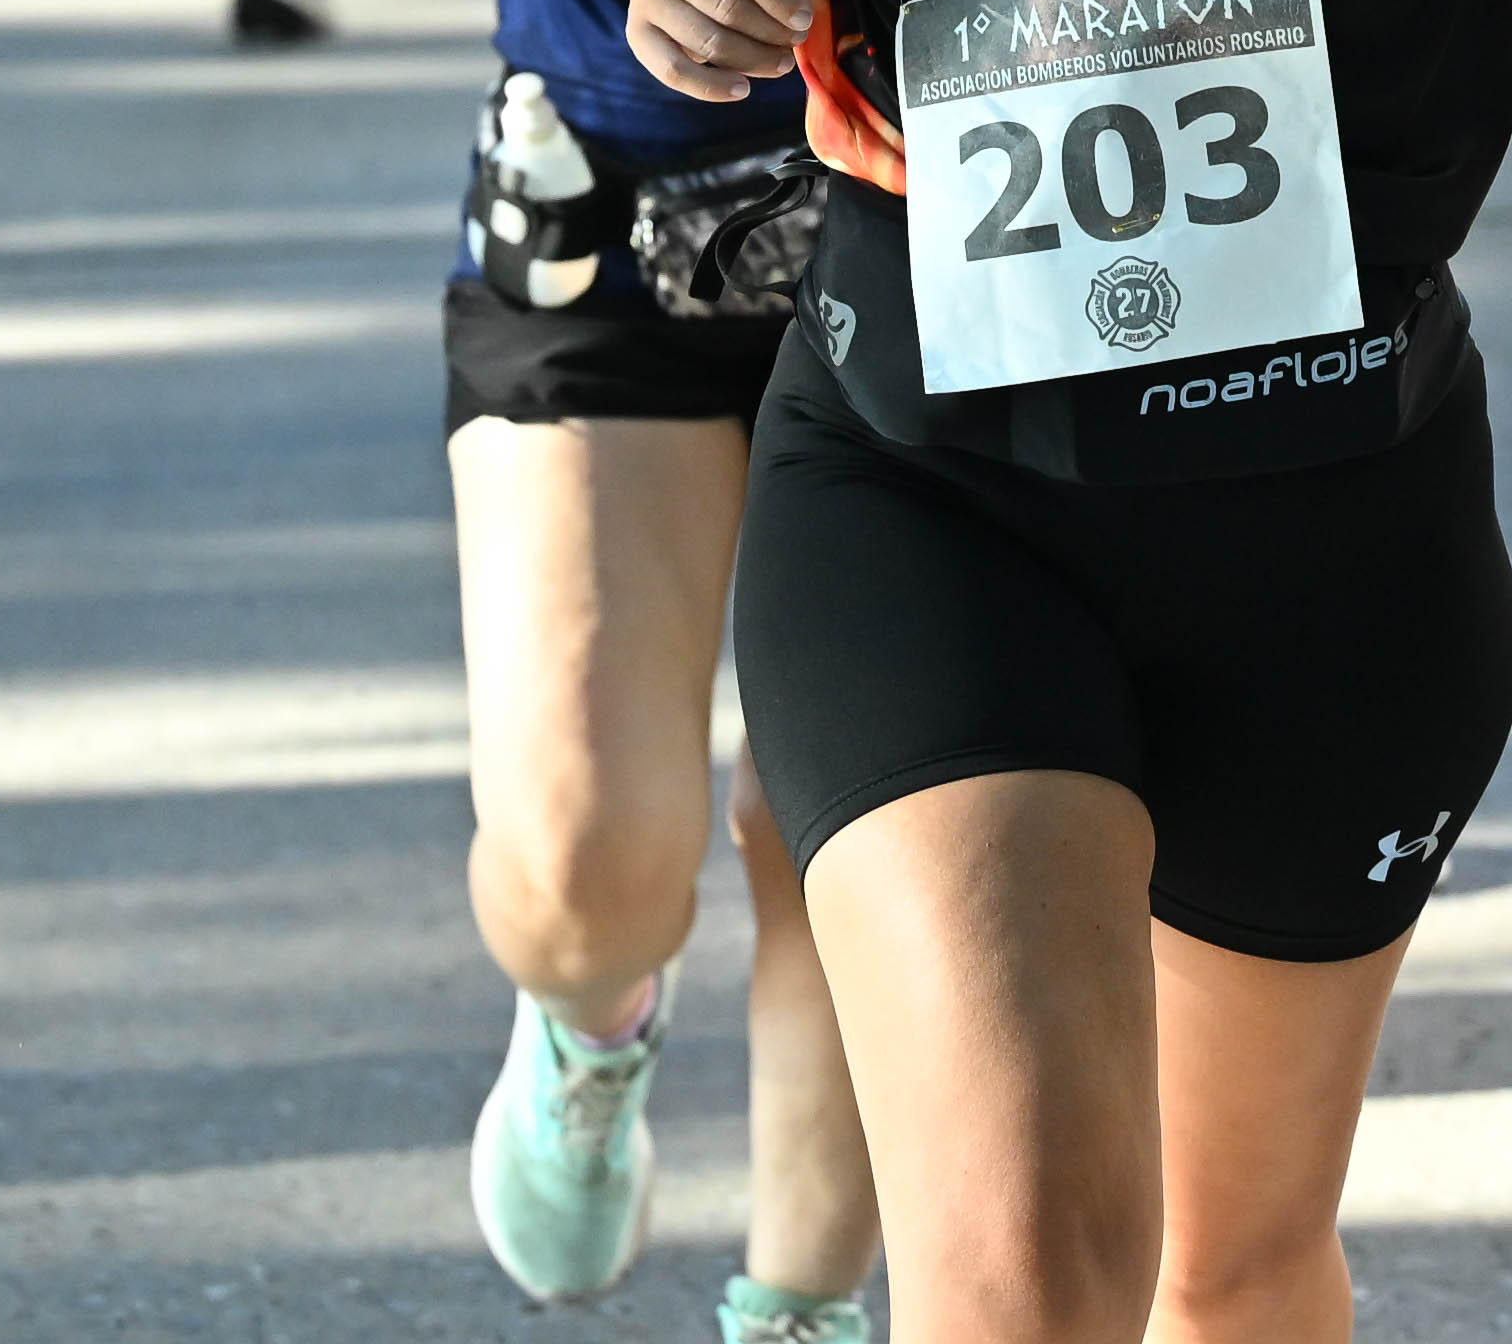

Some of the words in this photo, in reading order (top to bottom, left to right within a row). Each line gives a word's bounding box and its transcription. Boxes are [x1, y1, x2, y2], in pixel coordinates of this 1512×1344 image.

[919, 66, 1013, 103] ASOCIACIÓN
[1016, 53, 1106, 86] BOMBEROS
[1109, 35, 1226, 71] VOLUNTARIOS
[1230, 26, 1305, 52] ROSARIO
[953, 10, 991, 63] 1°
[959, 85, 1281, 262] 203
[1115, 287, 1151, 319] 27
[1139, 319, 1409, 415] noaflojes
